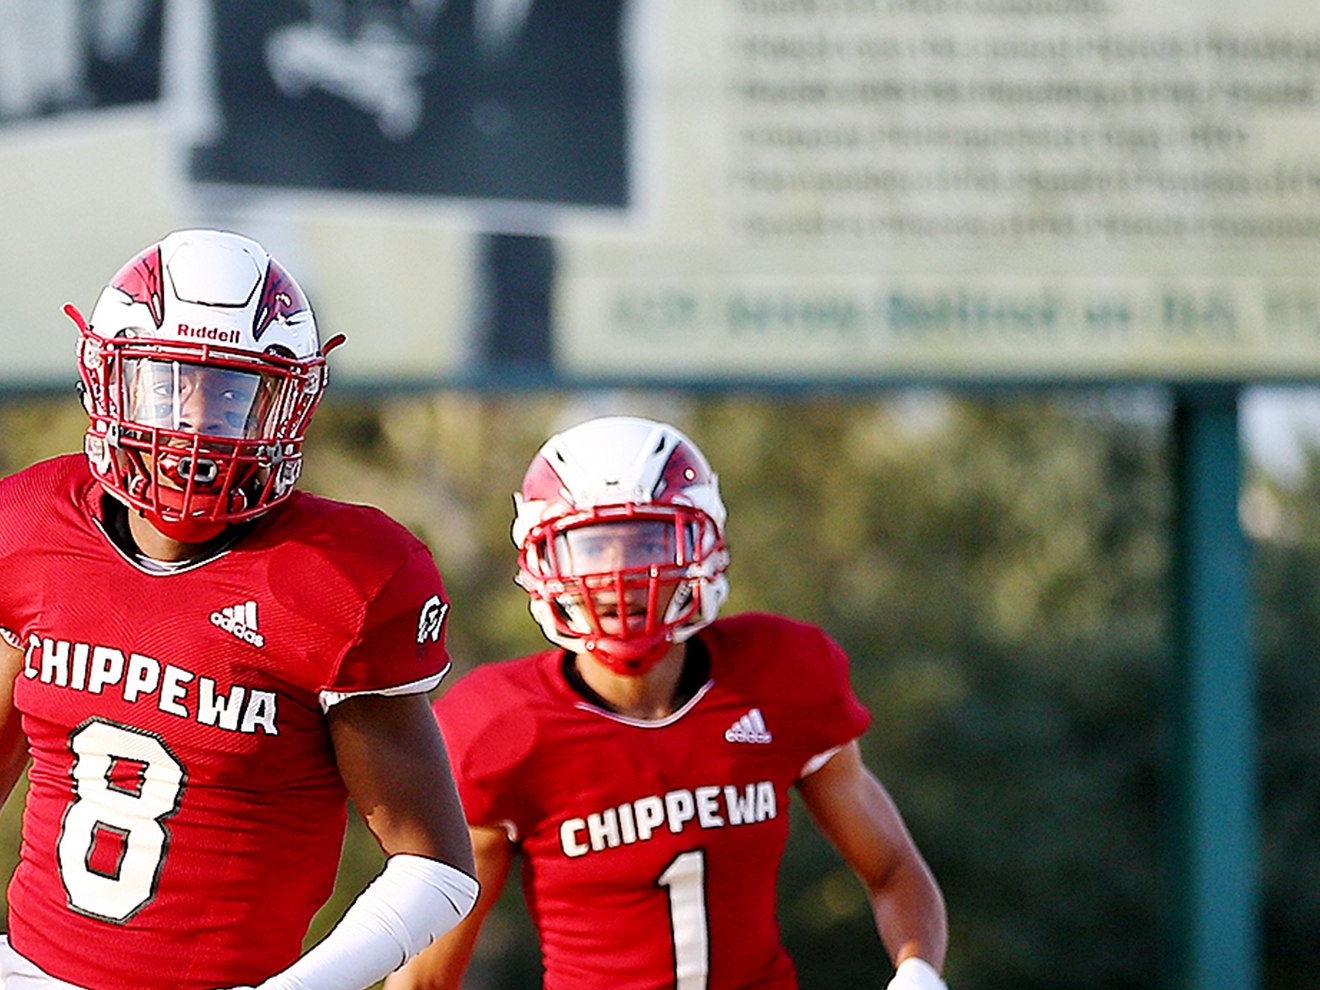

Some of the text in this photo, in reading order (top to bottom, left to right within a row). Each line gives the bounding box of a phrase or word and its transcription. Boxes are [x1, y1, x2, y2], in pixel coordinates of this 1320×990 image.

[178, 324, 240, 343] Riddell
[210, 611, 264, 648] adidas
[24, 633, 279, 736] CHIPPEWA
[58, 716, 187, 924] 8
[559, 781, 777, 858] CHIPPEWA
